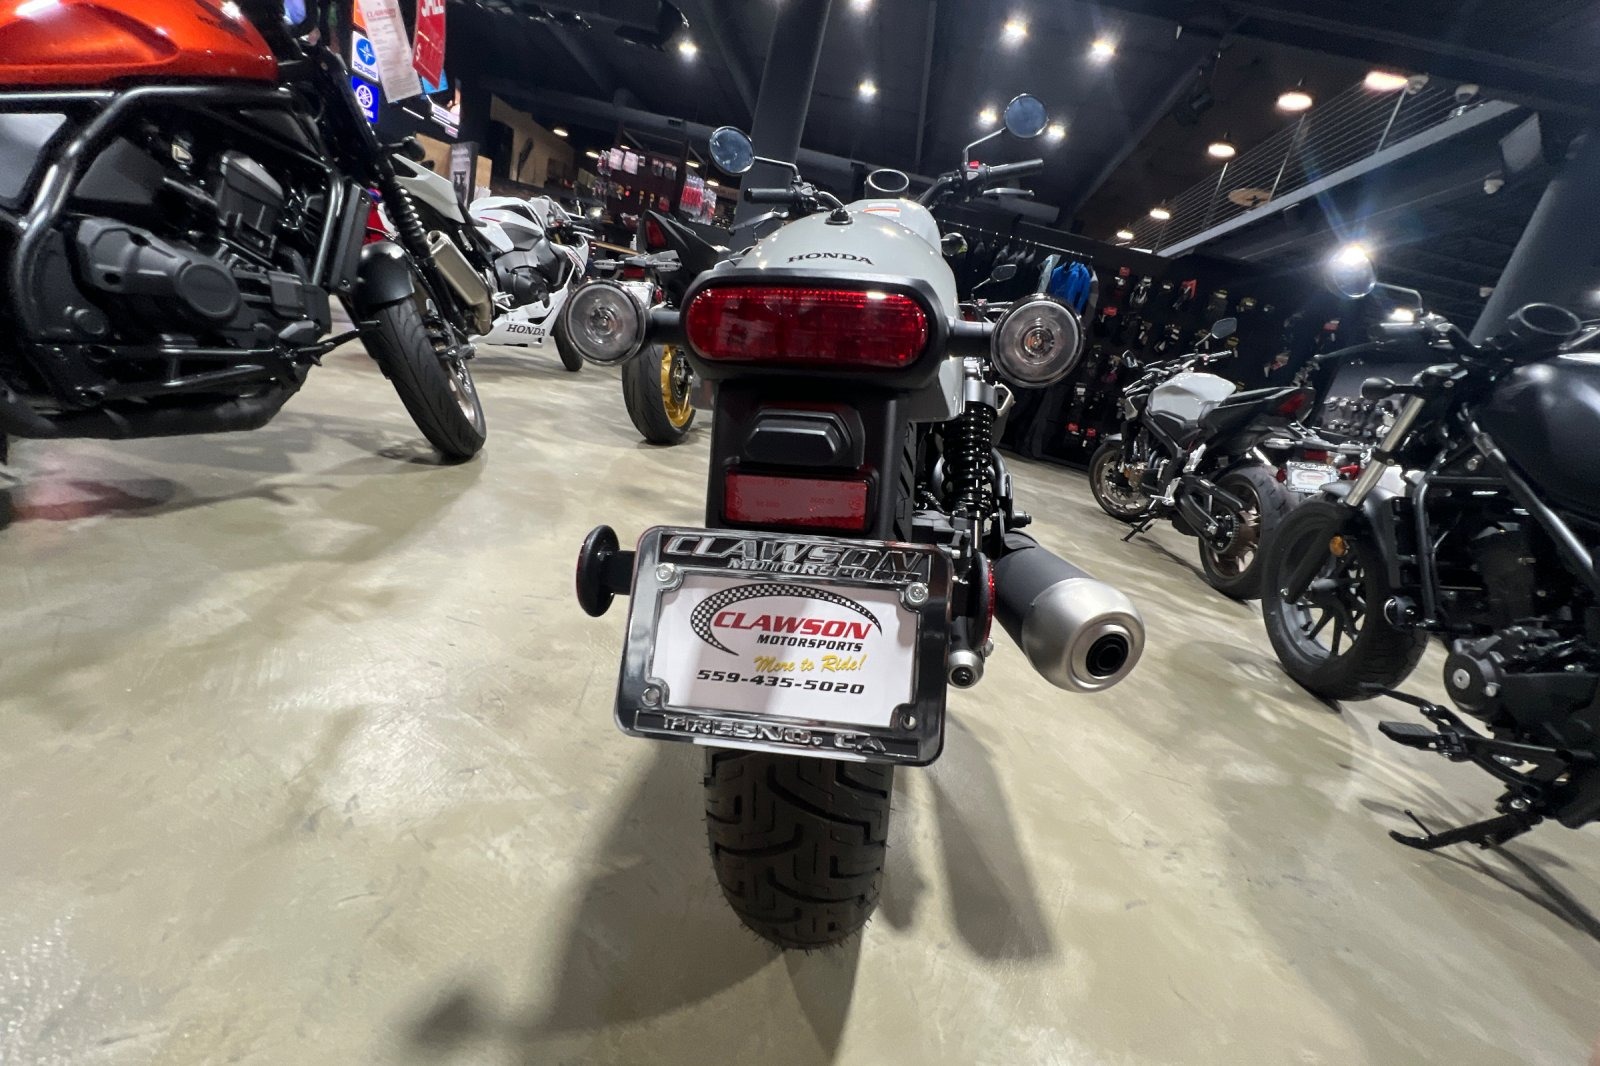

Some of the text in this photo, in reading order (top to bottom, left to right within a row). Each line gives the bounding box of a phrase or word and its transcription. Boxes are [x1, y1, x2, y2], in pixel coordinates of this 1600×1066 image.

[786, 251, 875, 266] HONDA
[506, 323, 546, 337] HONDA
[665, 536, 924, 572] CLAWSON
[713, 611, 872, 640] CLAWSON
[756, 634, 863, 652] MOTORSPORTS
[753, 653, 867, 673] More to Ride!
[696, 669, 865, 695] 559-435-5020
[833, 732, 887, 752] CA
